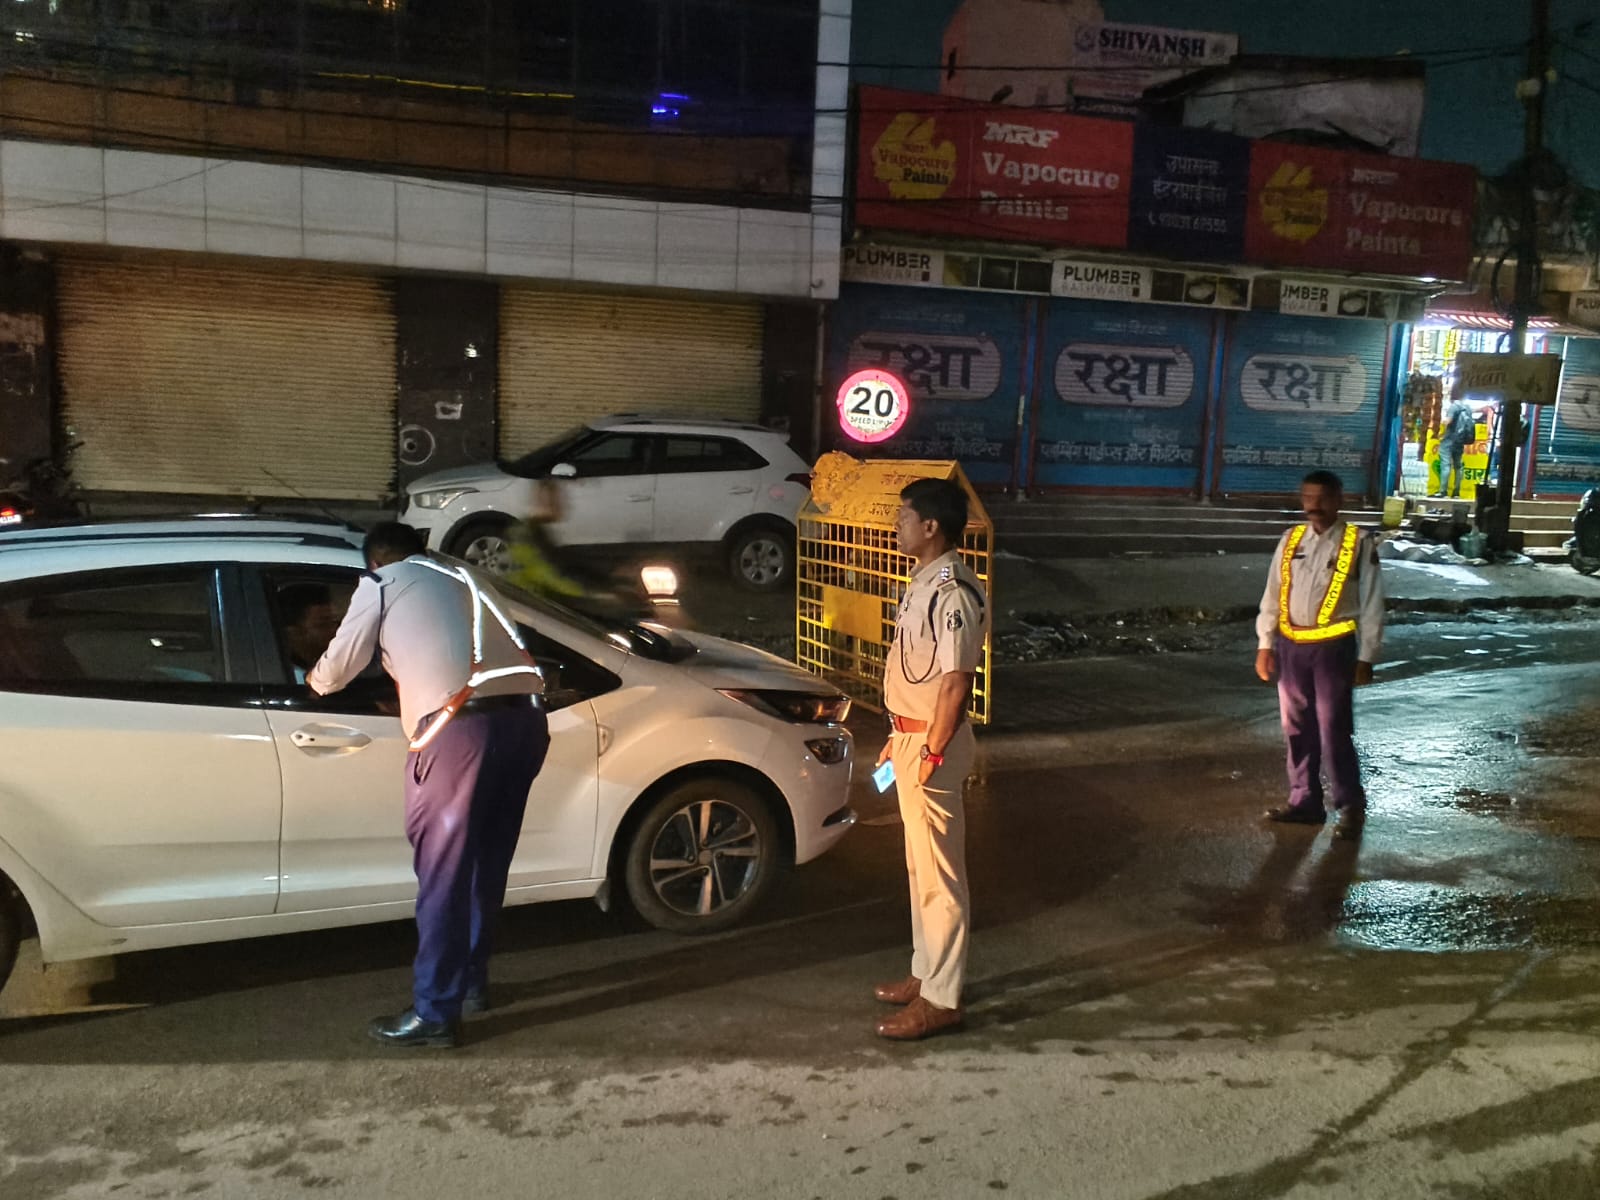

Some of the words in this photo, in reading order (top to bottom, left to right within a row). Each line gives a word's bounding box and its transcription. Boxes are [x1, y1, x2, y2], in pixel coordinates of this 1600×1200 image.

[1098, 28, 1205, 58] SHIVANSH
[982, 121, 1058, 148] MRF
[903, 167, 949, 184] Paints
[982, 151, 1120, 190] Vapocure
[978, 190, 1069, 221] Paints
[1351, 191, 1462, 226] Vapocure
[1346, 226, 1422, 254] Paints
[844, 247, 931, 269] PLUMBER
[1064, 265, 1140, 285] PLUMBER
[1067, 352, 1178, 402] रक्षा
[1252, 362, 1353, 408] रक्षा
[851, 386, 894, 417] 20
[851, 415, 872, 425] SPEED
